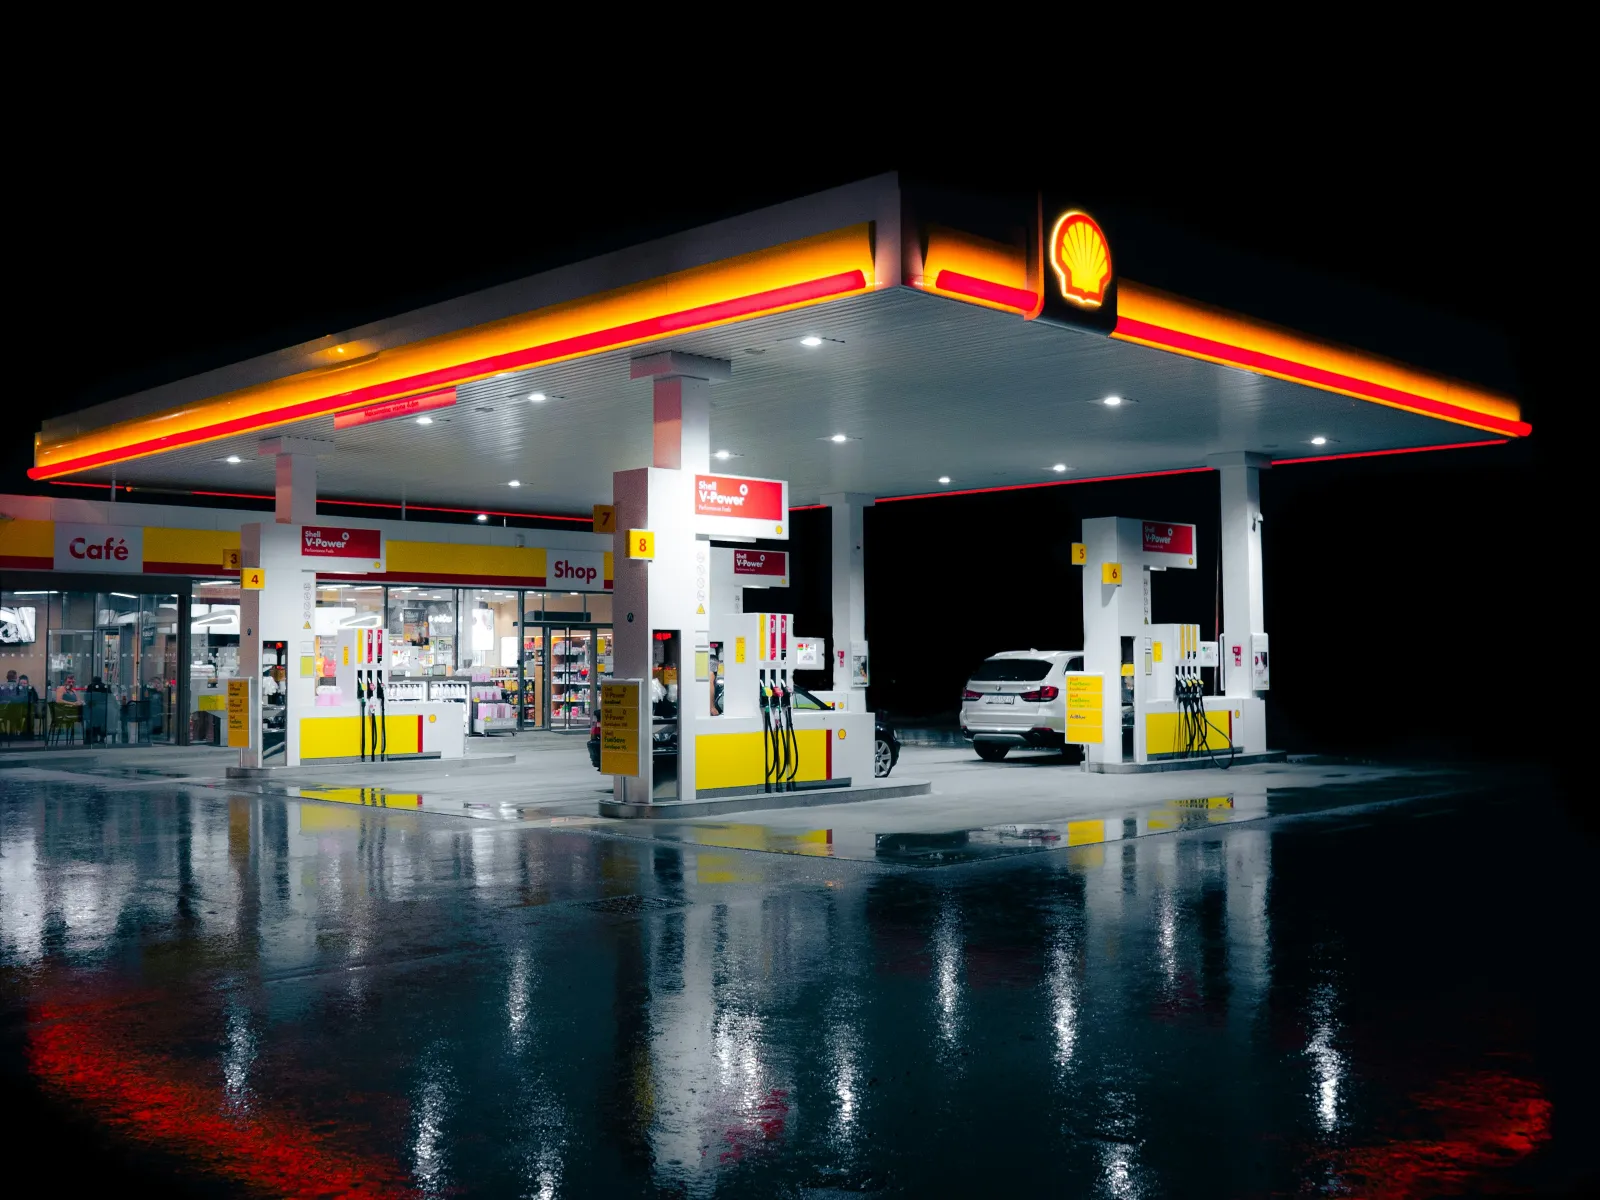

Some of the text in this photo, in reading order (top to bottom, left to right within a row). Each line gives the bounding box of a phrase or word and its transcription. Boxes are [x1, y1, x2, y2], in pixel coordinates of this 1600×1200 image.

[698, 480, 717, 491] Shell
[698, 490, 745, 506] V-Power
[602, 512, 611, 526] 7
[305, 530, 321, 538] Shell
[1145, 533, 1171, 544] V-Power
[305, 537, 347, 548] V-Power
[639, 538, 647, 552] 8
[69, 537, 129, 561] Café
[1079, 548, 1085, 559] 5
[230, 553, 238, 564] 3
[736, 559, 764, 568] V-Power
[554, 559, 597, 585] Shop
[1112, 568, 1118, 579] 6
[251, 574, 259, 585] 4
